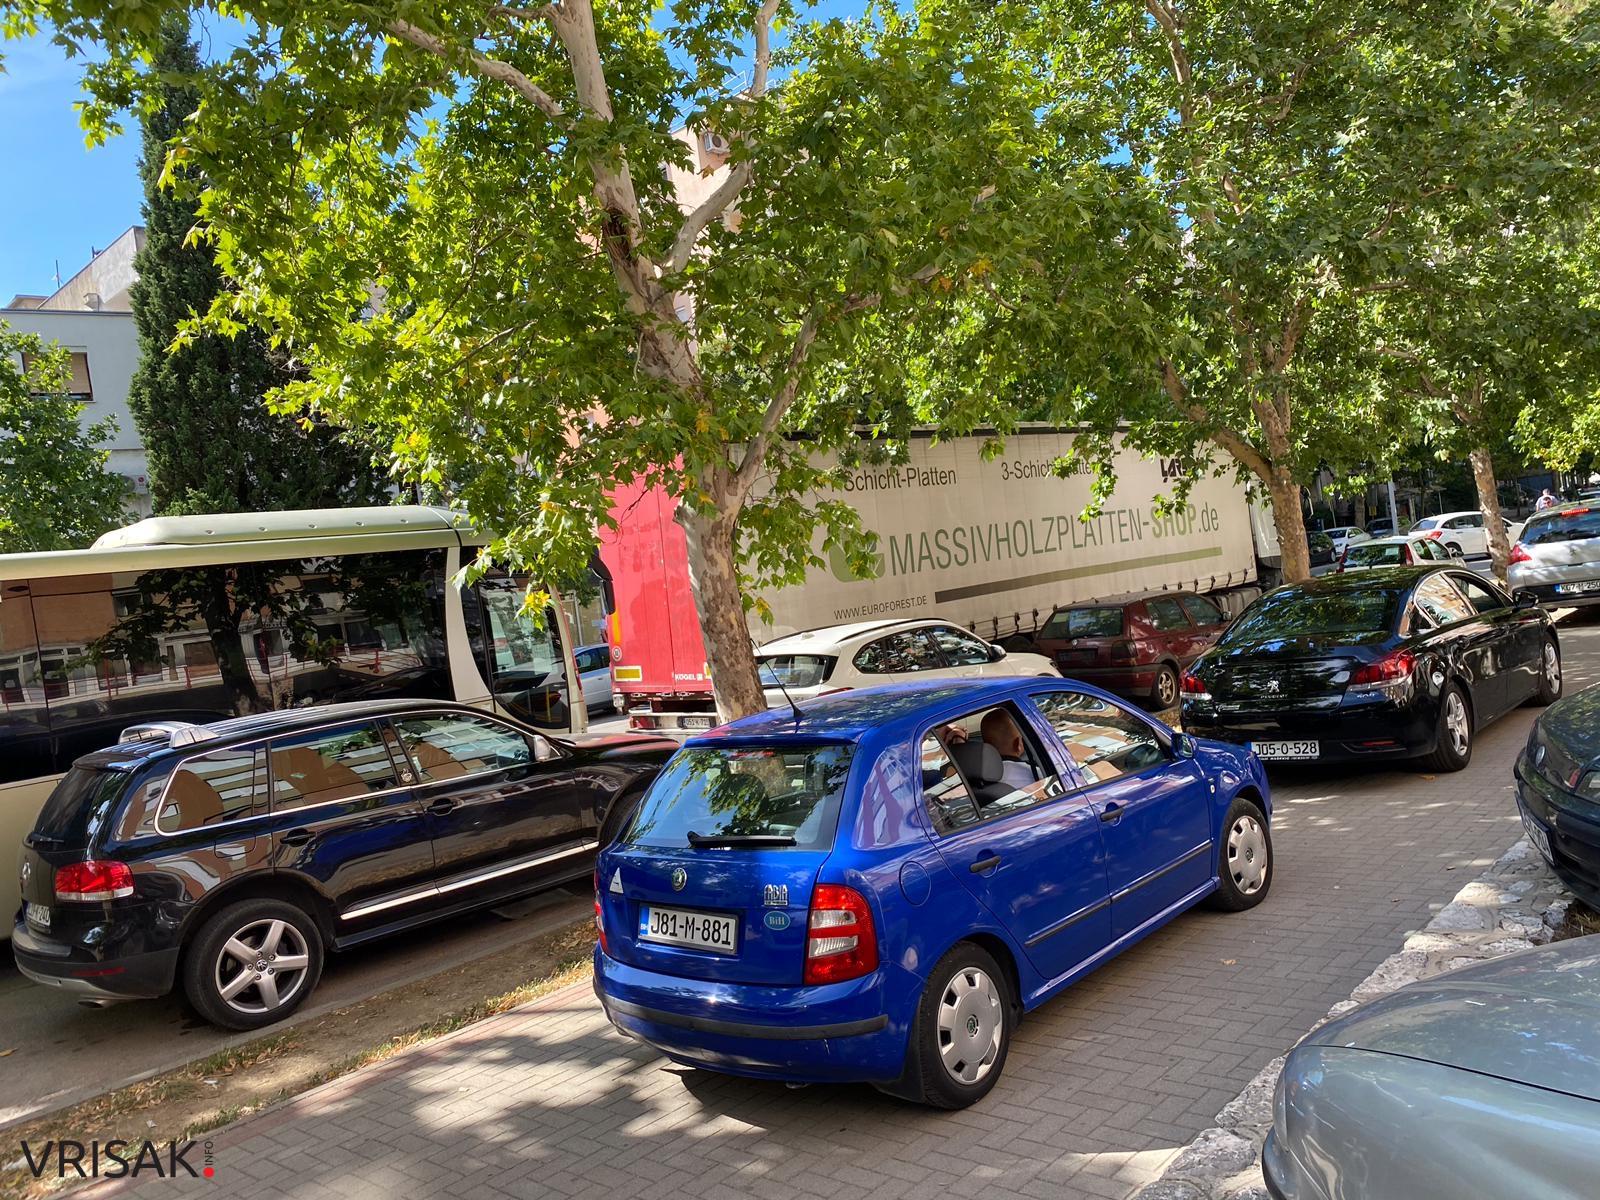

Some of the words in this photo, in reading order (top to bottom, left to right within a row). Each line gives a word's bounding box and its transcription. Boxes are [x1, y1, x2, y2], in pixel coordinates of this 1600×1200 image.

[834, 595, 927, 620] WWW.EUROFOREST.DE
[764, 884, 788, 900] FABIA
[651, 912, 731, 945] J81-M-881
